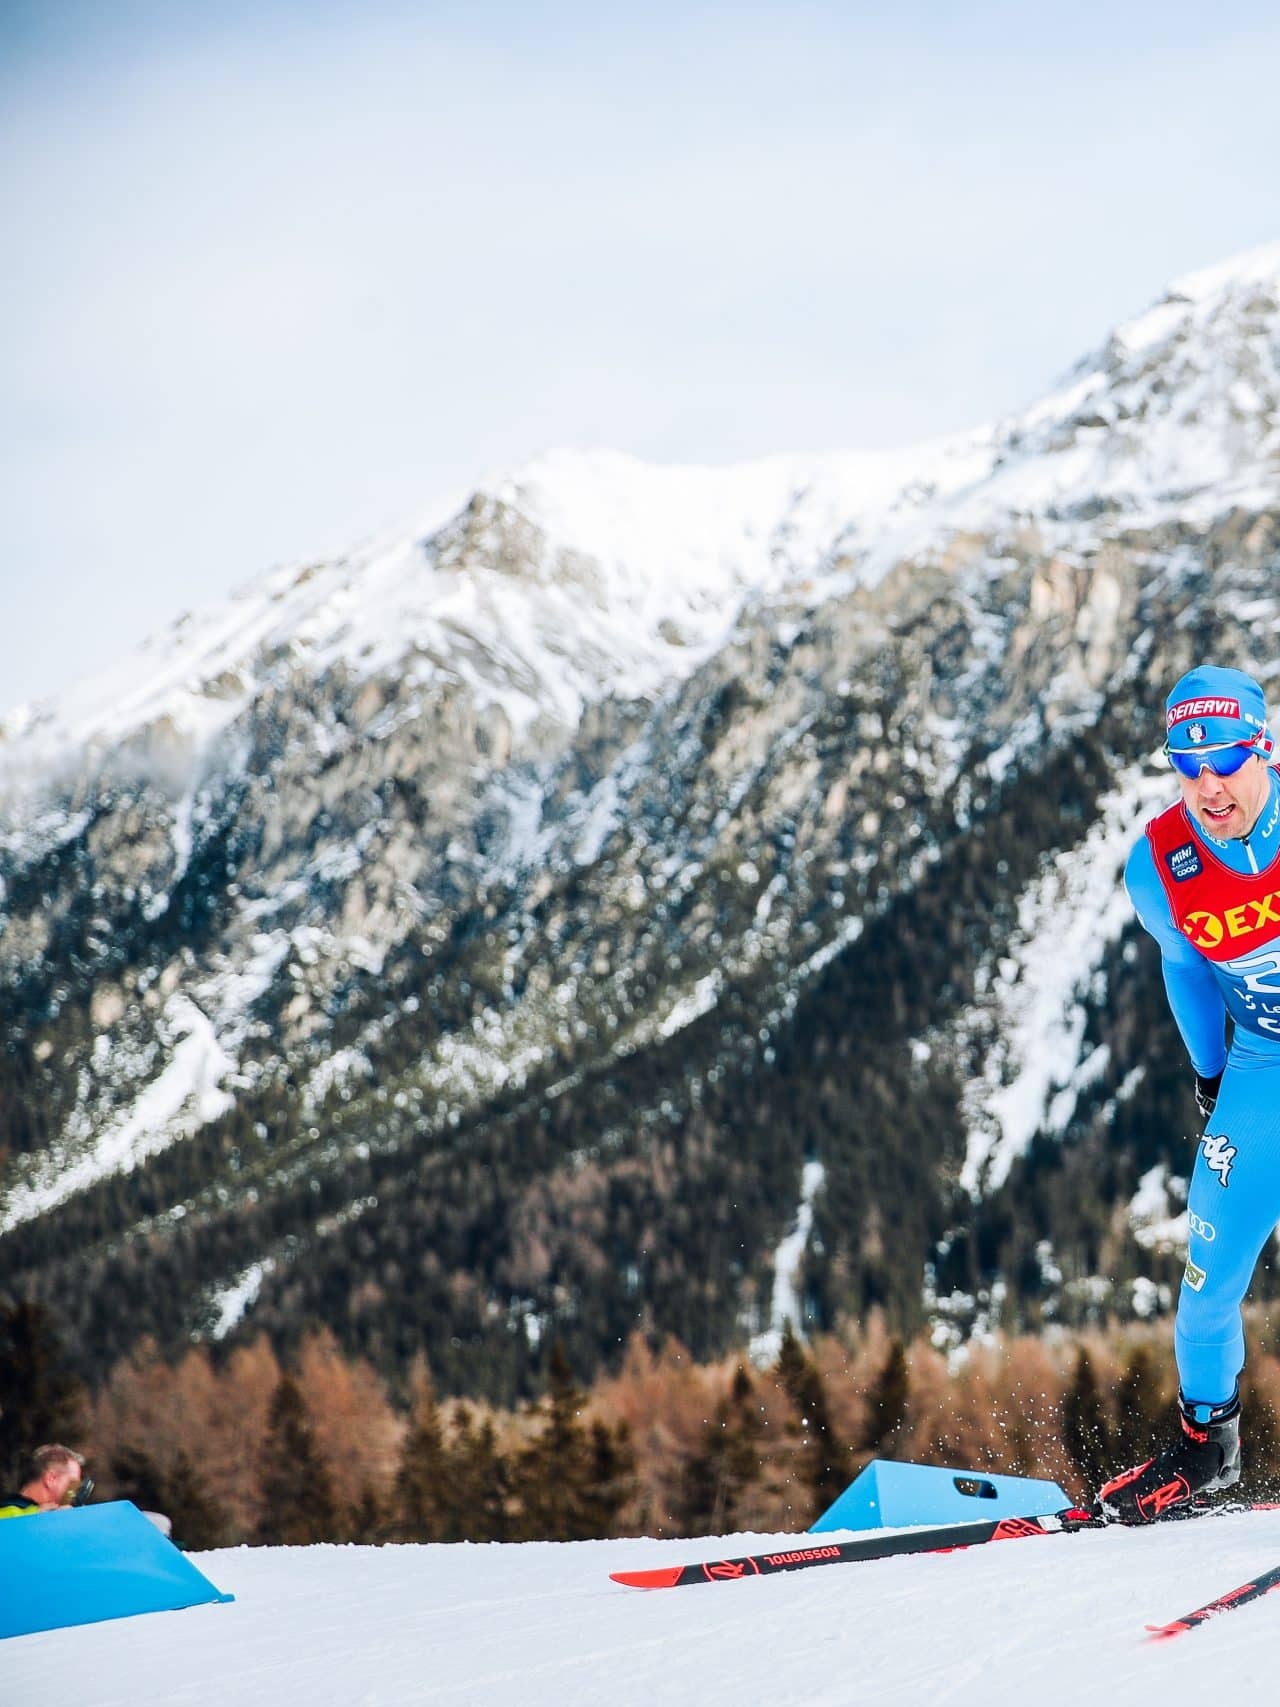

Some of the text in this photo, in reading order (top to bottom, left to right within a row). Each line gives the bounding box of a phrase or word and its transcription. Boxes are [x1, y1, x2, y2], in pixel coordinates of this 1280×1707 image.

[1176, 699, 1238, 720] ENERVIT
[1176, 864, 1198, 877] coop
[762, 1546, 841, 1566] ROSSIGNOL
